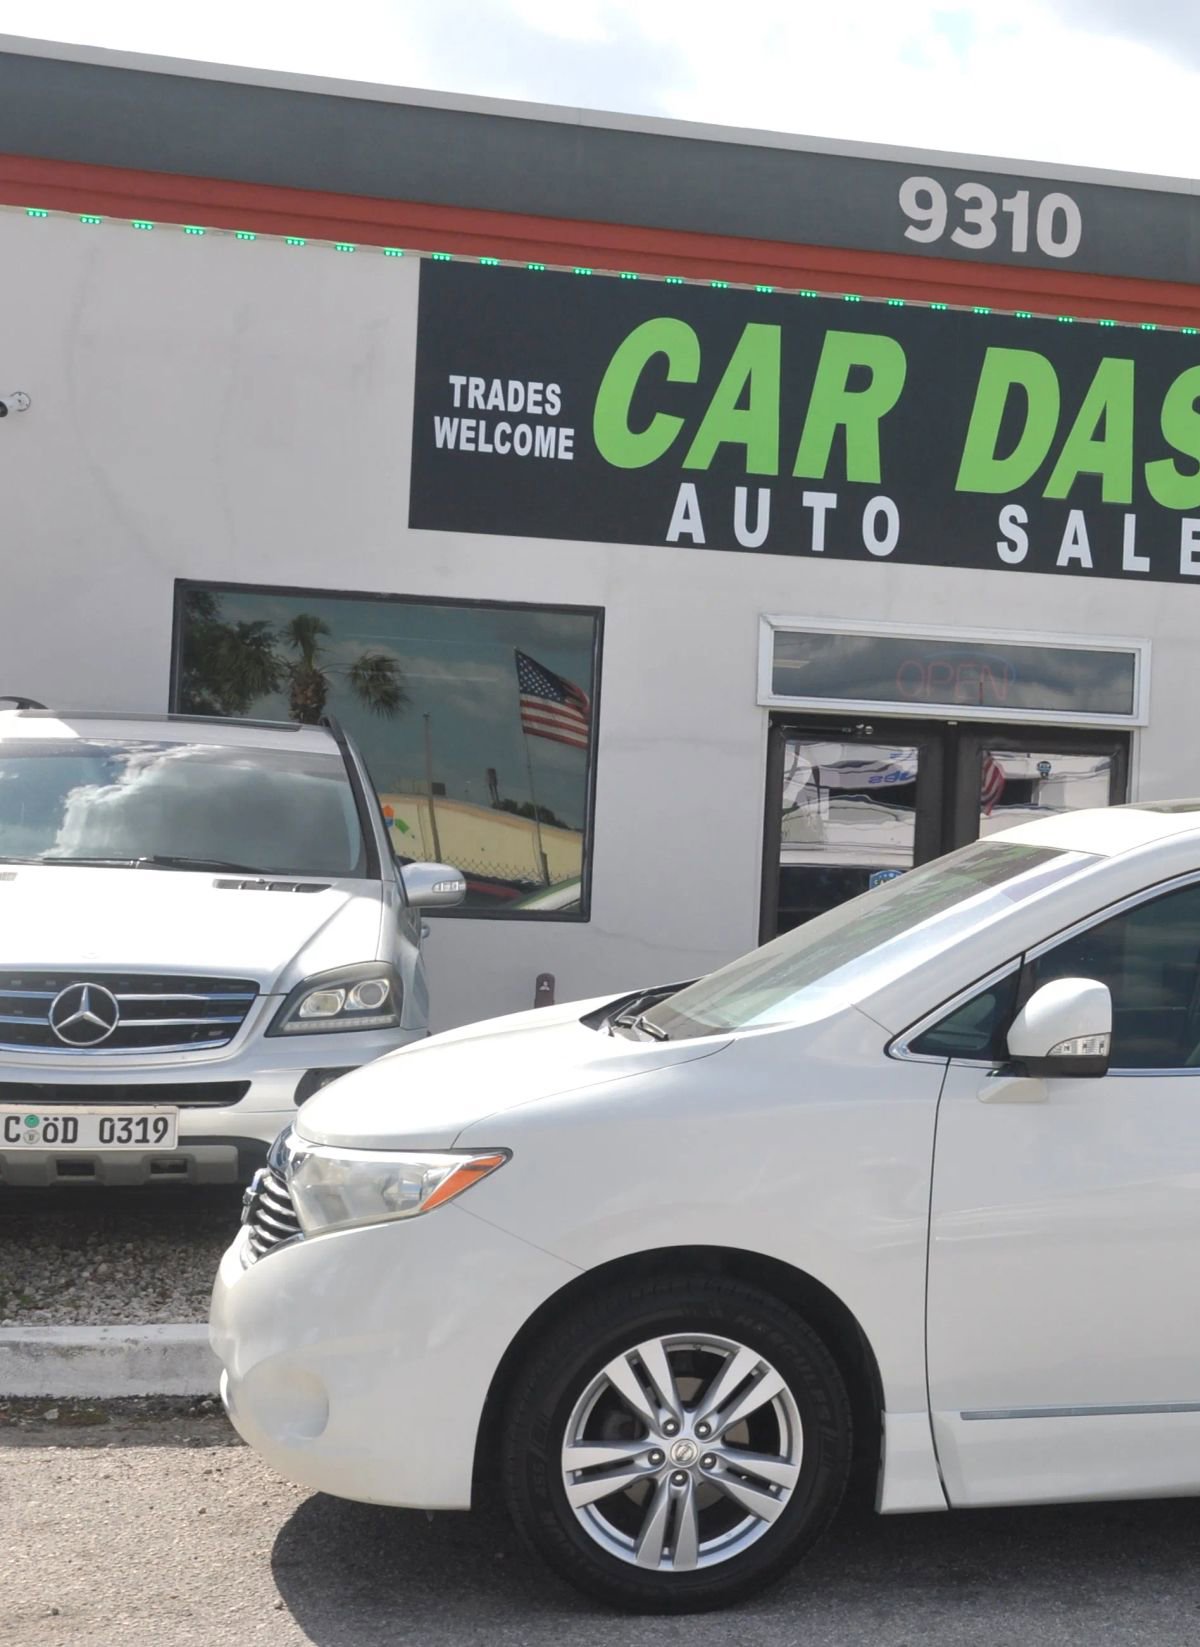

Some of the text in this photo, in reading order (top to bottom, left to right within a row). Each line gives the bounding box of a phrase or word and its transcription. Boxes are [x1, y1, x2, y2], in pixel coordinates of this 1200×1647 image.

[899, 175, 1083, 259] 9310
[449, 374, 562, 416] TRADES
[593, 316, 907, 485] CAR
[433, 415, 575, 460] WELCOME
[666, 482, 901, 557] AUTO
[896, 660, 1009, 702] OPEN
[98, 1116, 169, 1144] 0319
